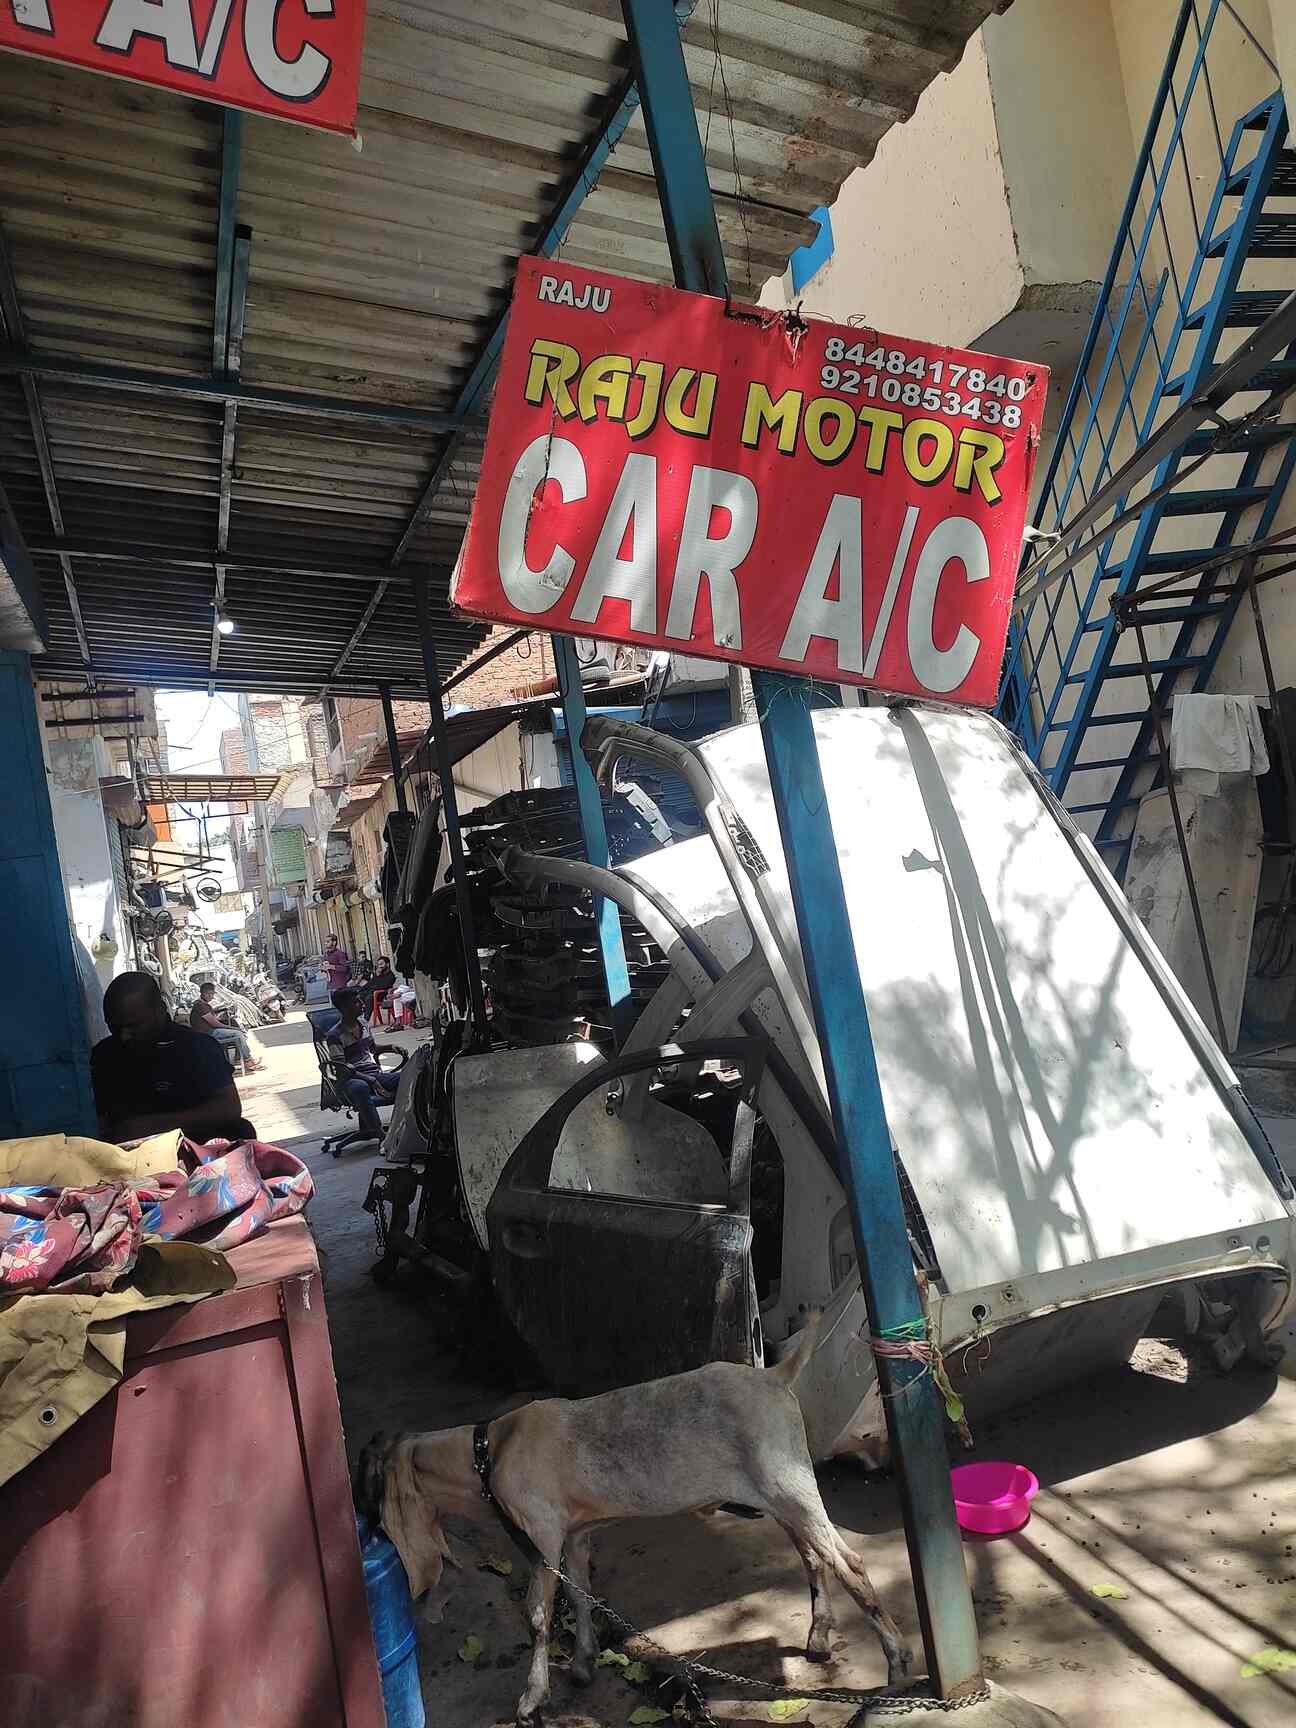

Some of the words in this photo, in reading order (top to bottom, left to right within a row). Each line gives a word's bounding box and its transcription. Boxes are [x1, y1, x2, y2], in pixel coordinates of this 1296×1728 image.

[538, 275, 611, 313] RAJU
[820, 365, 1022, 428] 9210853438
[825, 337, 1025, 401] 8448417840
[525, 338, 718, 441] RAJU
[740, 381, 1003, 507] MOTOR
[497, 433, 759, 650] CAR
[778, 493, 991, 694] A/C
